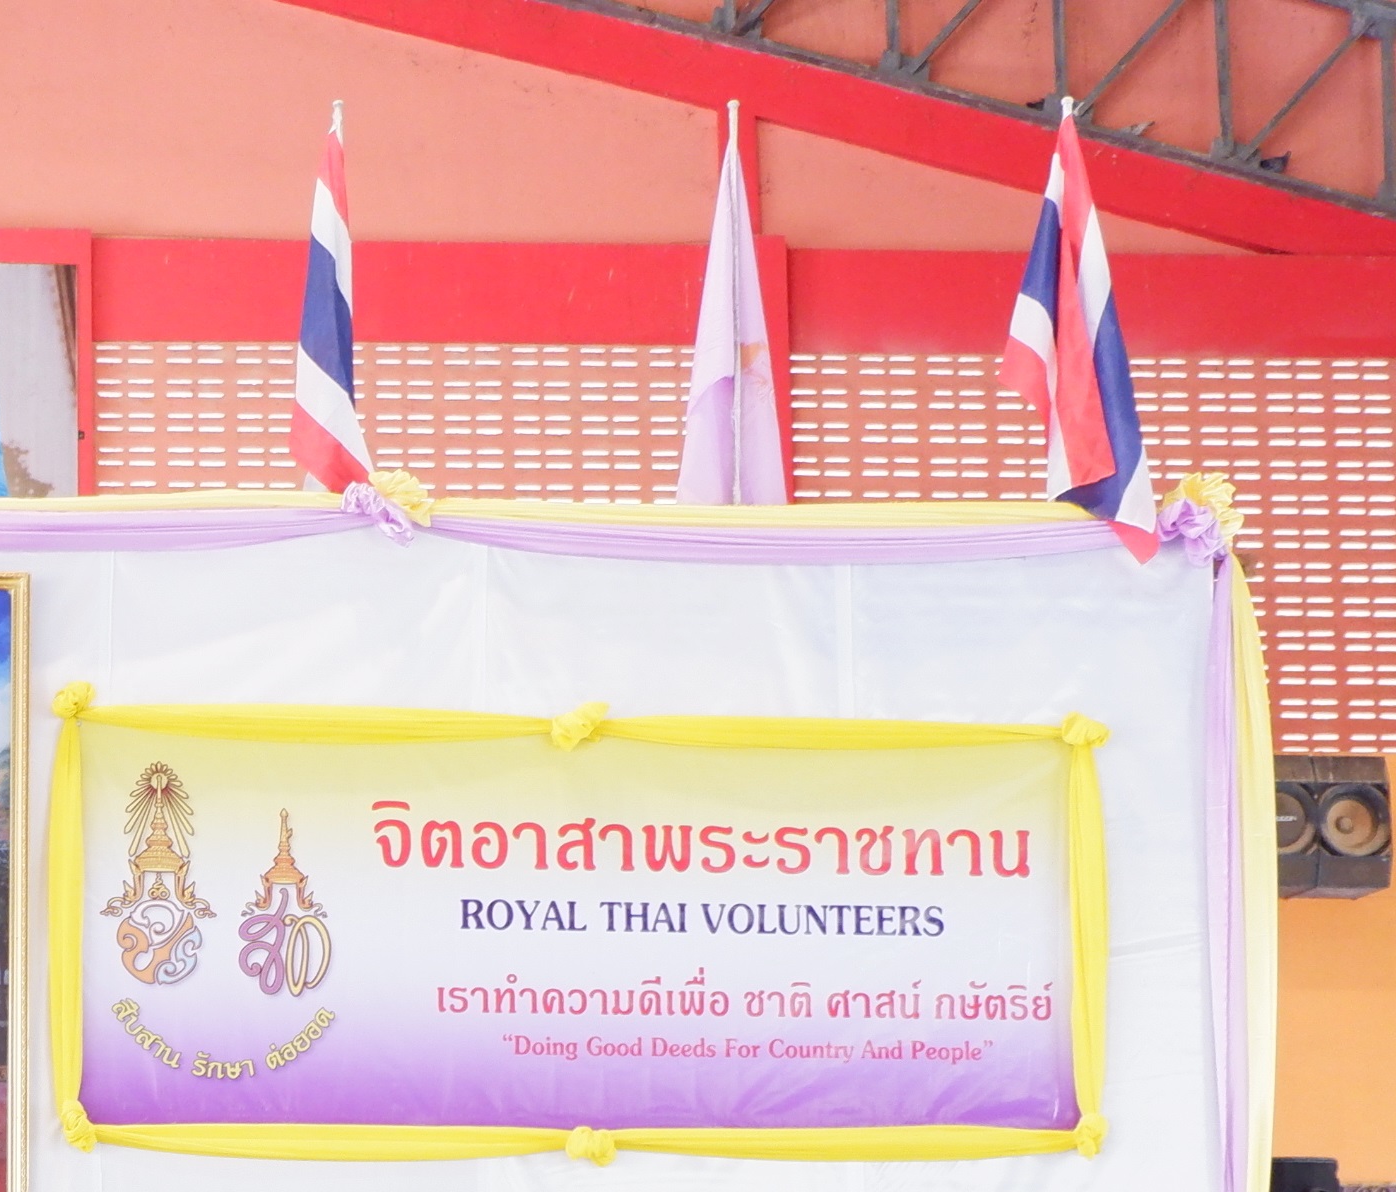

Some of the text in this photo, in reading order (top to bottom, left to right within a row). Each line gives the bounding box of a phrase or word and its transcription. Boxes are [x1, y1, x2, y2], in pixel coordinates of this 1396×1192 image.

[371, 800, 1031, 879] จิตอาสาพระราชทาน
[460, 898, 946, 937] ROYAL THAI VOLUNTEERS
[436, 966, 1053, 1021] เราทำความดีเพื่อ ชาติ ศาสน์ กษัตริย์
[110, 997, 336, 1080] สืบสาน รักษา ต่อยอด
[502, 1033, 994, 1065] “Doing Good Deeds For Country And People”
